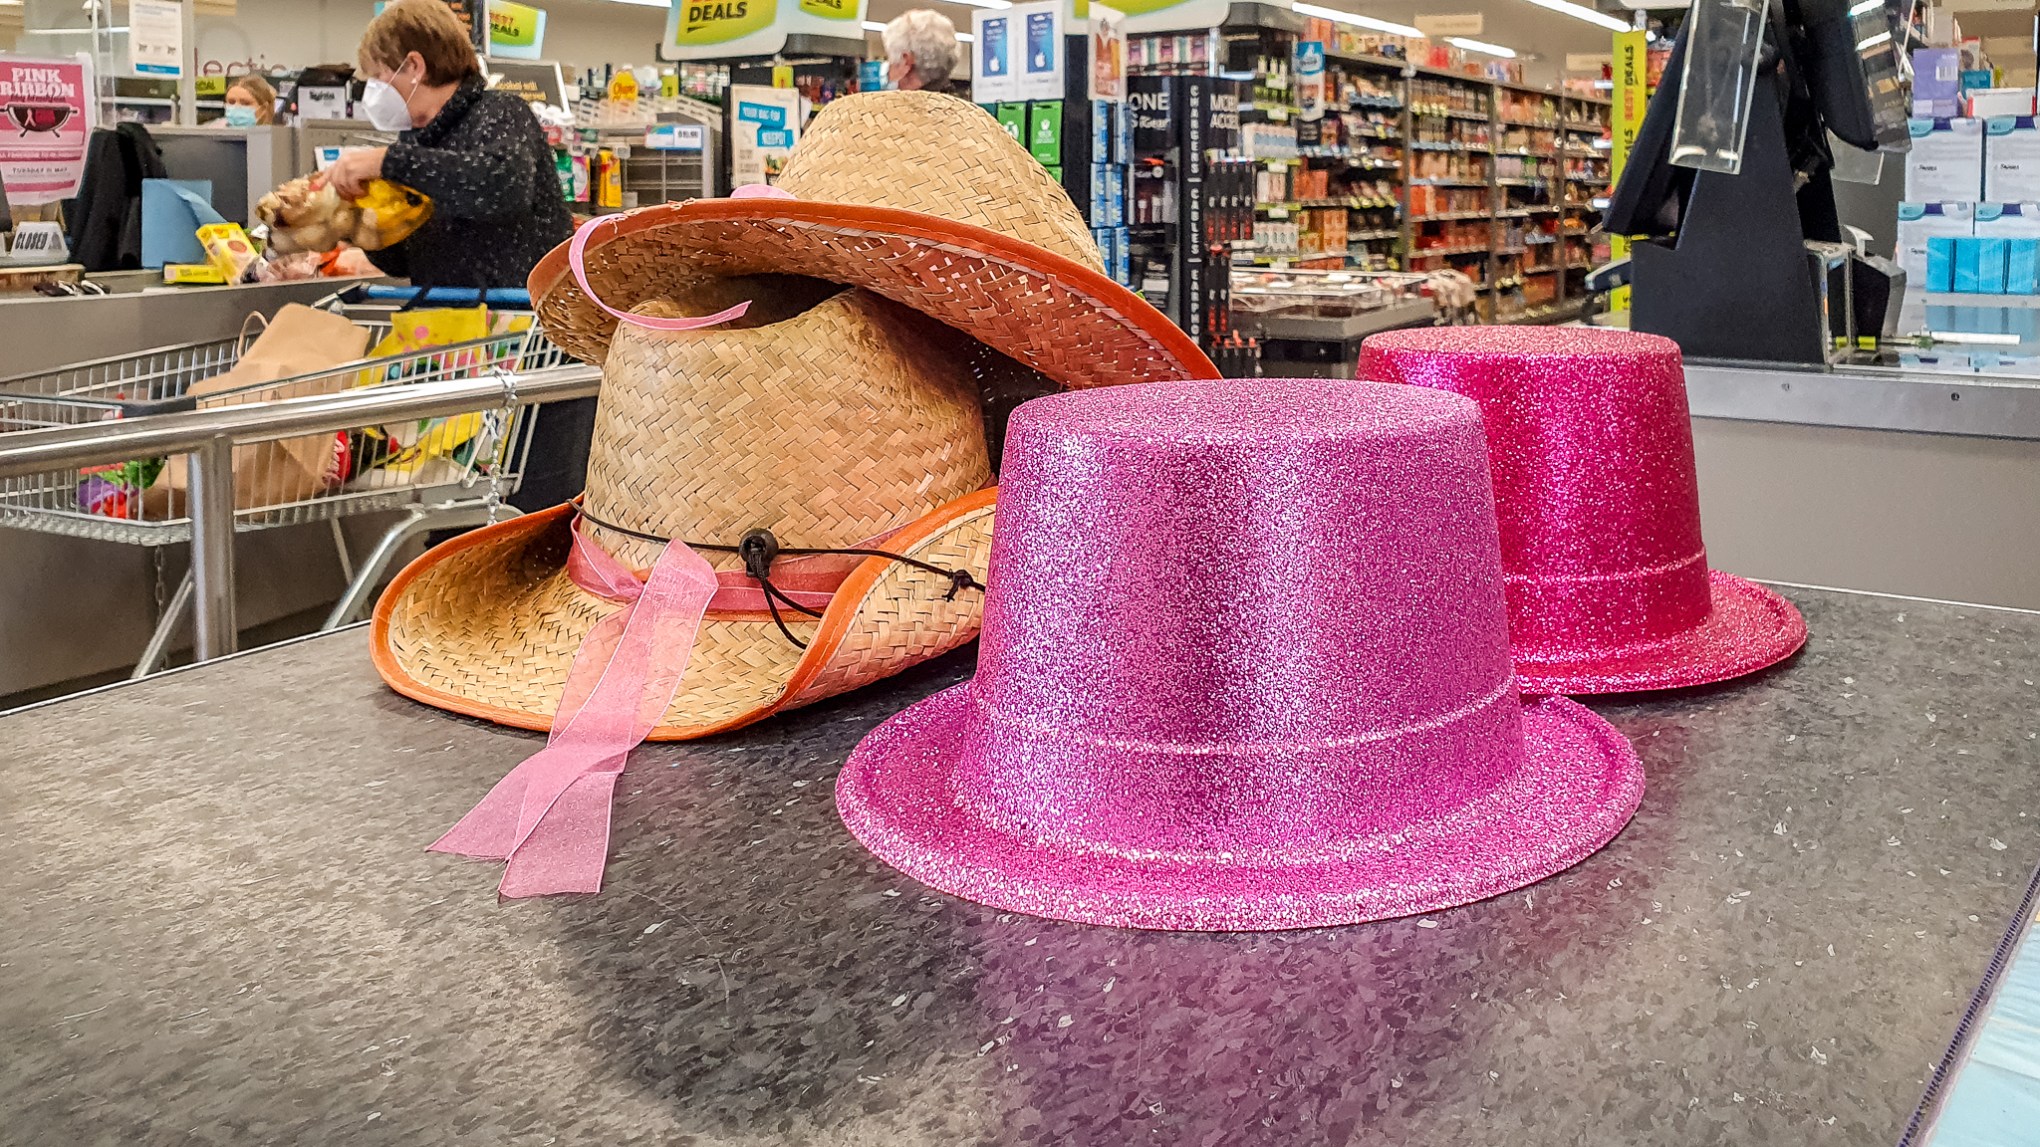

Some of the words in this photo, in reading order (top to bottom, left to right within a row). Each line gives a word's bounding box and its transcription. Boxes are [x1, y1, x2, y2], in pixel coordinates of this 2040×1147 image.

[689, 1, 748, 23] DEALS
[11, 67, 63, 83] PINK
[1624, 44, 1634, 86] DEALS
[0, 81, 75, 97] RIBBON
[1128, 91, 1170, 111] ONE
[1190, 85, 1199, 174] CHARGERS
[1191, 188, 1199, 254] CABLES
[15, 231, 48, 250] CLOSED
